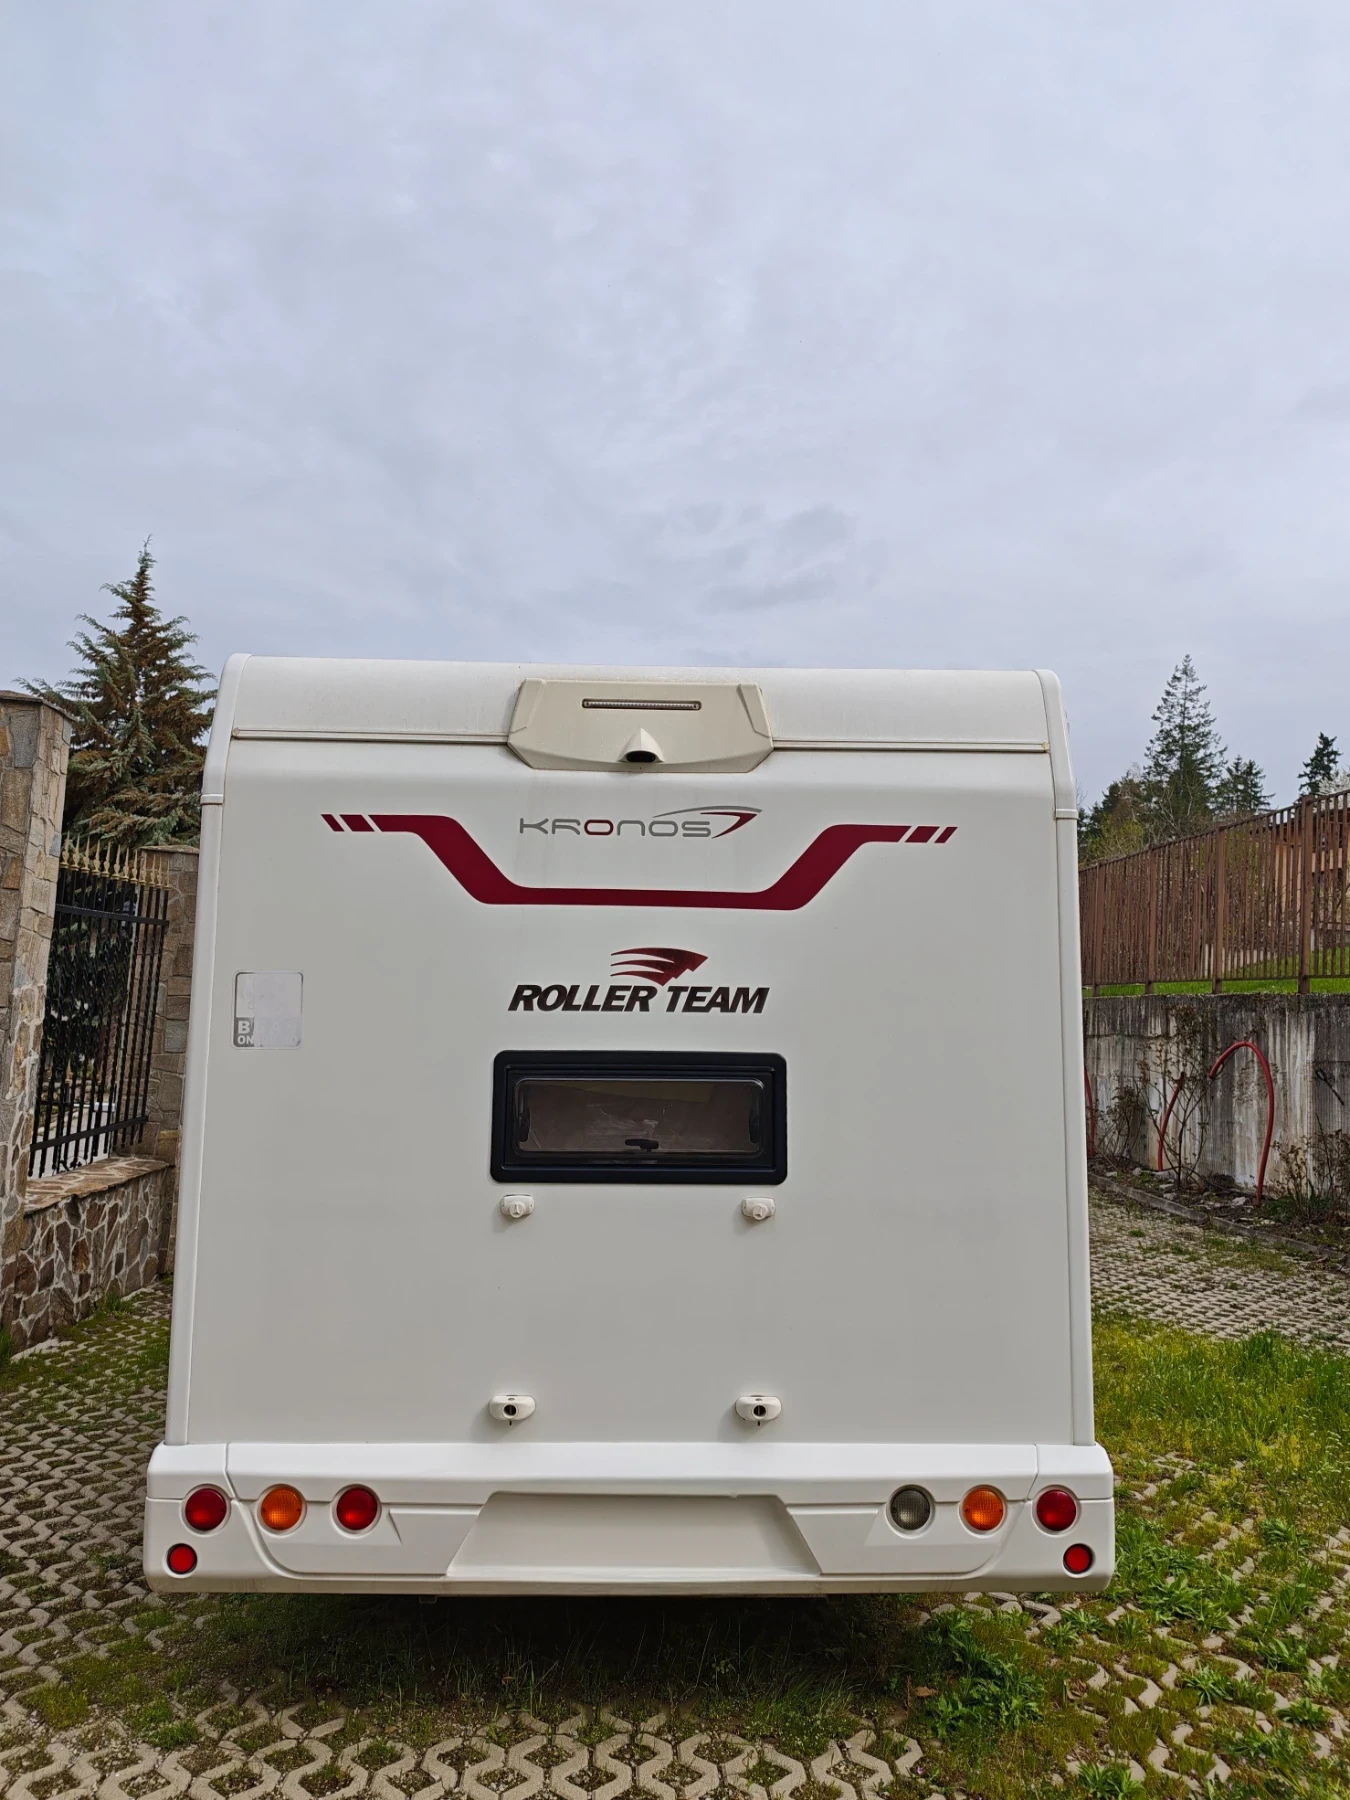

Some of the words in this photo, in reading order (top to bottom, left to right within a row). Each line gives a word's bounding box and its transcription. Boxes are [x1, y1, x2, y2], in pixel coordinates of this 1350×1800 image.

[520, 817, 711, 837] KRONOS
[508, 984, 658, 1012] ROLLER
[666, 985, 770, 1014] TEAM
